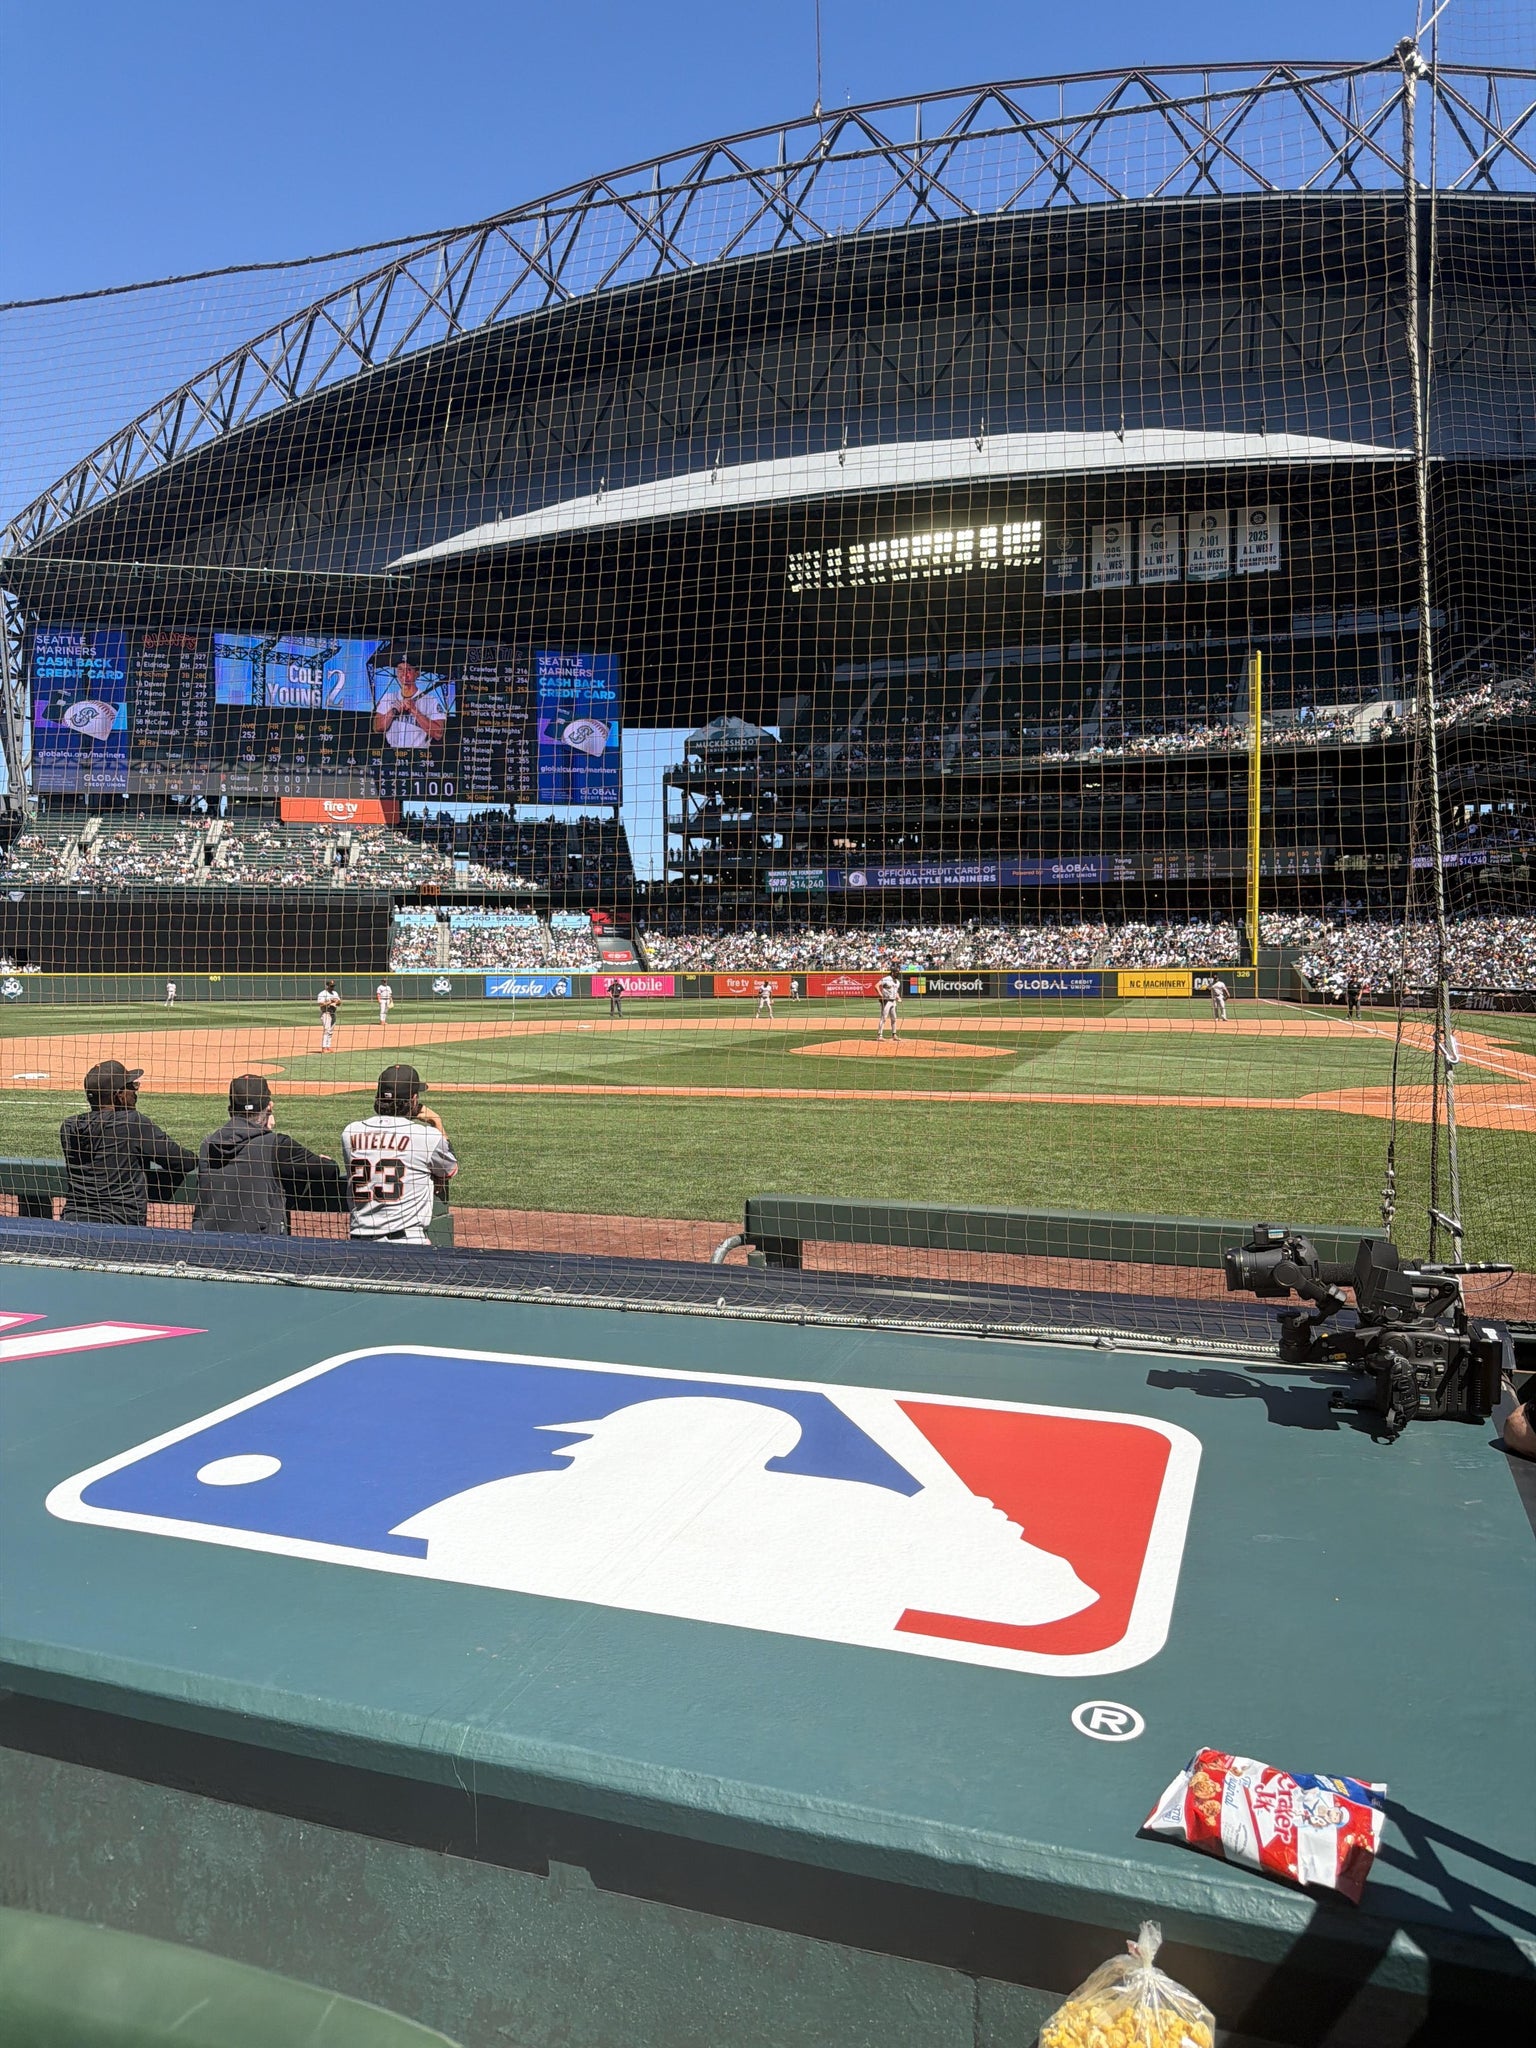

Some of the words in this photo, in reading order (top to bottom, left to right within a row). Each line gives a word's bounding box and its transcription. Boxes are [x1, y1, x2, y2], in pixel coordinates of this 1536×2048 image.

[1248, 530, 1268, 542] 2025
[1207, 548, 1224, 558] WEST
[1189, 561, 1228, 573] CHAMPIONS
[1240, 556, 1277, 567] CHAMPIONS
[1140, 566, 1178, 578] CHAMPIONS
[36, 636, 86, 645] SEATTLE
[36, 645, 97, 656] MARINERS
[36, 656, 72, 667] CASH
[76, 658, 112, 668] BACK
[538, 657, 583, 667] SEATTLE
[36, 668, 84, 678] CREDIT
[87, 670, 124, 680] CARD
[290, 665, 322, 685] COLE
[540, 667, 592, 677] MARINERS
[267, 683, 321, 708] YOUNG
[327, 669, 346, 708] 2
[540, 678, 571, 687] CASH
[574, 679, 605, 688] BACK
[540, 689, 581, 698] CREDIT
[584, 690, 616, 700] CARD
[695, 738, 759, 749] MUCKLESHOOT
[84, 774, 126, 782] GLOBAL
[414, 782, 420, 795] 1
[429, 782, 438, 795] 0
[445, 782, 453, 796] 0
[323, 801, 344, 812] fire
[346, 803, 358, 812] tv
[1052, 863, 1097, 873] GLOBAL
[944, 875, 996, 883] MARINERS
[6, 982, 19, 991] 50
[435, 980, 448, 989] 50
[490, 979, 544, 996] Alaska
[727, 978, 740, 987] fire
[930, 979, 983, 991] Microsoft
[1014, 980, 1068, 990] GLOBAL
[1144, 980, 1186, 988] MACHINERY
[350, 1132, 410, 1152] VITELLO
[349, 1158, 406, 1203] 23
